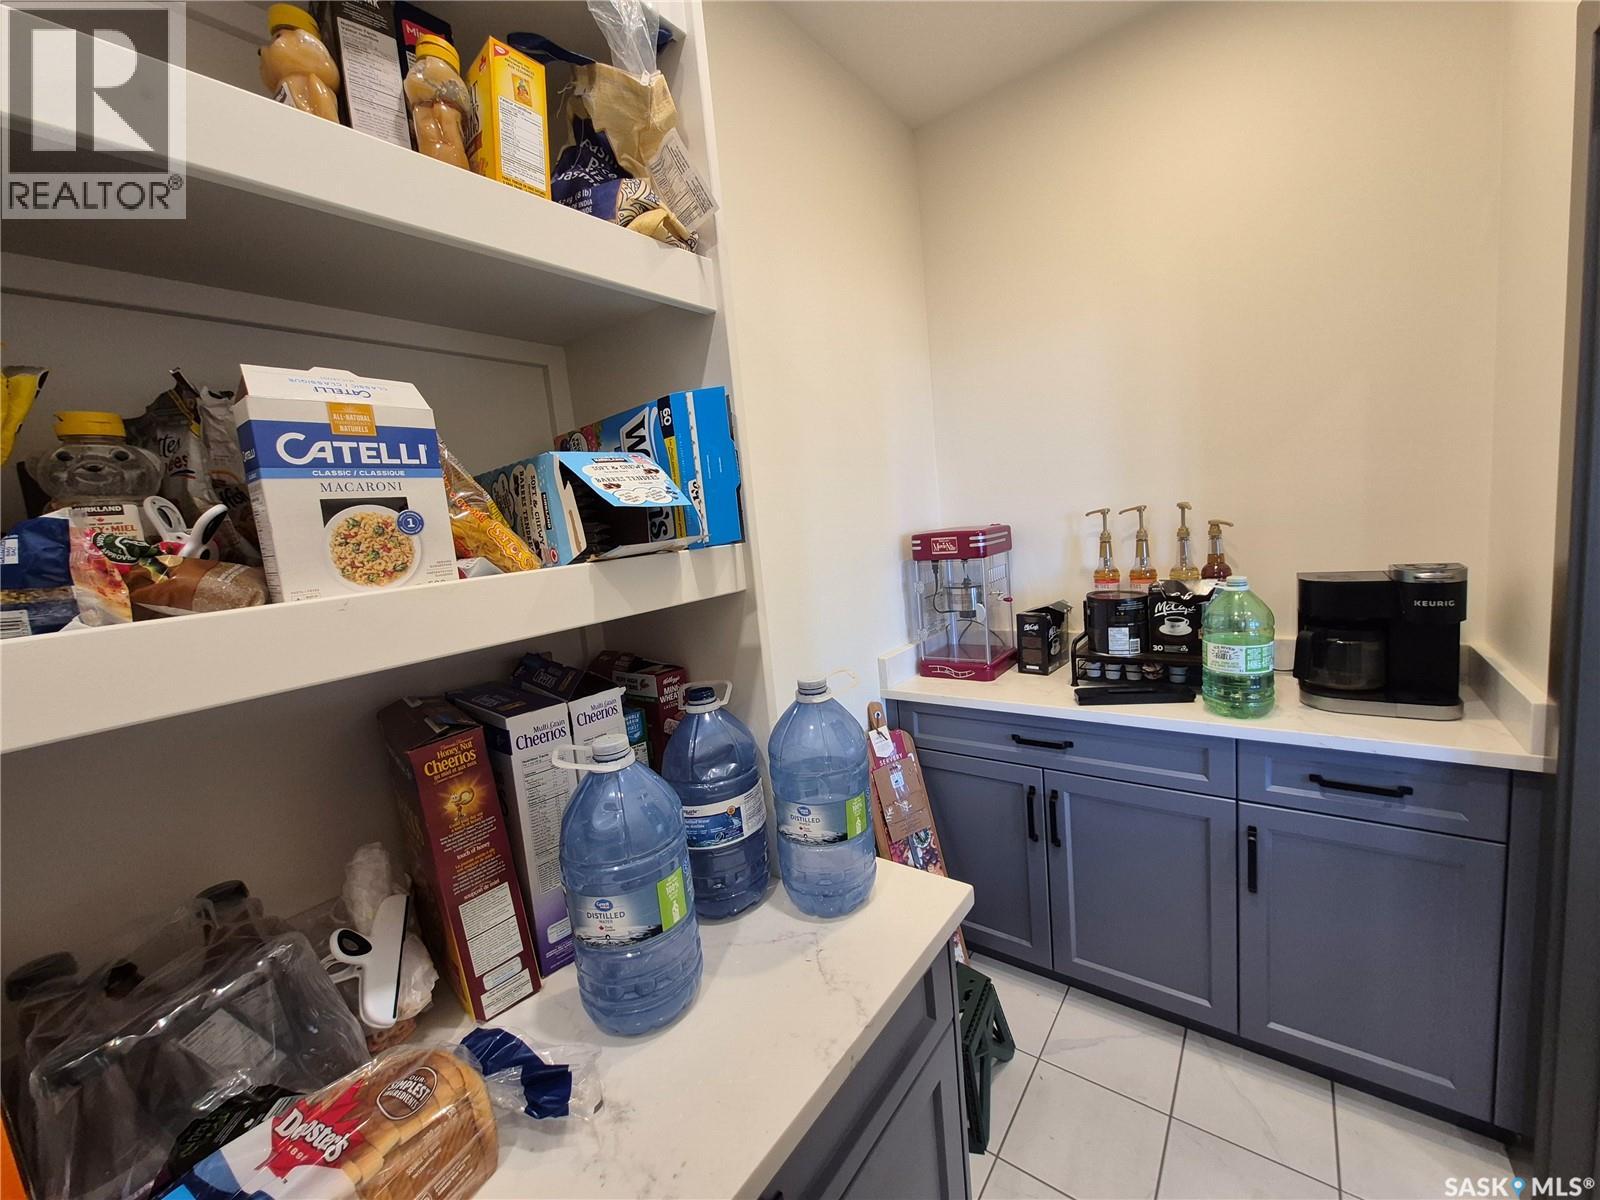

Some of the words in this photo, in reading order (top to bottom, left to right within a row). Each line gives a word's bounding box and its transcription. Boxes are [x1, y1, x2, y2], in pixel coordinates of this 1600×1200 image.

[313, 386, 372, 399] CATELLI
[662, 407, 672, 426] 60
[276, 432, 428, 465] CATELLI
[319, 481, 403, 493] MACARONI
[406, 518, 415, 528] 1
[1152, 644, 1164, 652] 30
[576, 704, 619, 727] Cheerios
[516, 726, 567, 751] Cheerios
[437, 746, 459, 759] Honey
[460, 741, 473, 751] Nut
[424, 749, 477, 777] Cheerios
[790, 814, 821, 824] DISTILLED
[586, 911, 626, 919] DISTILLED
